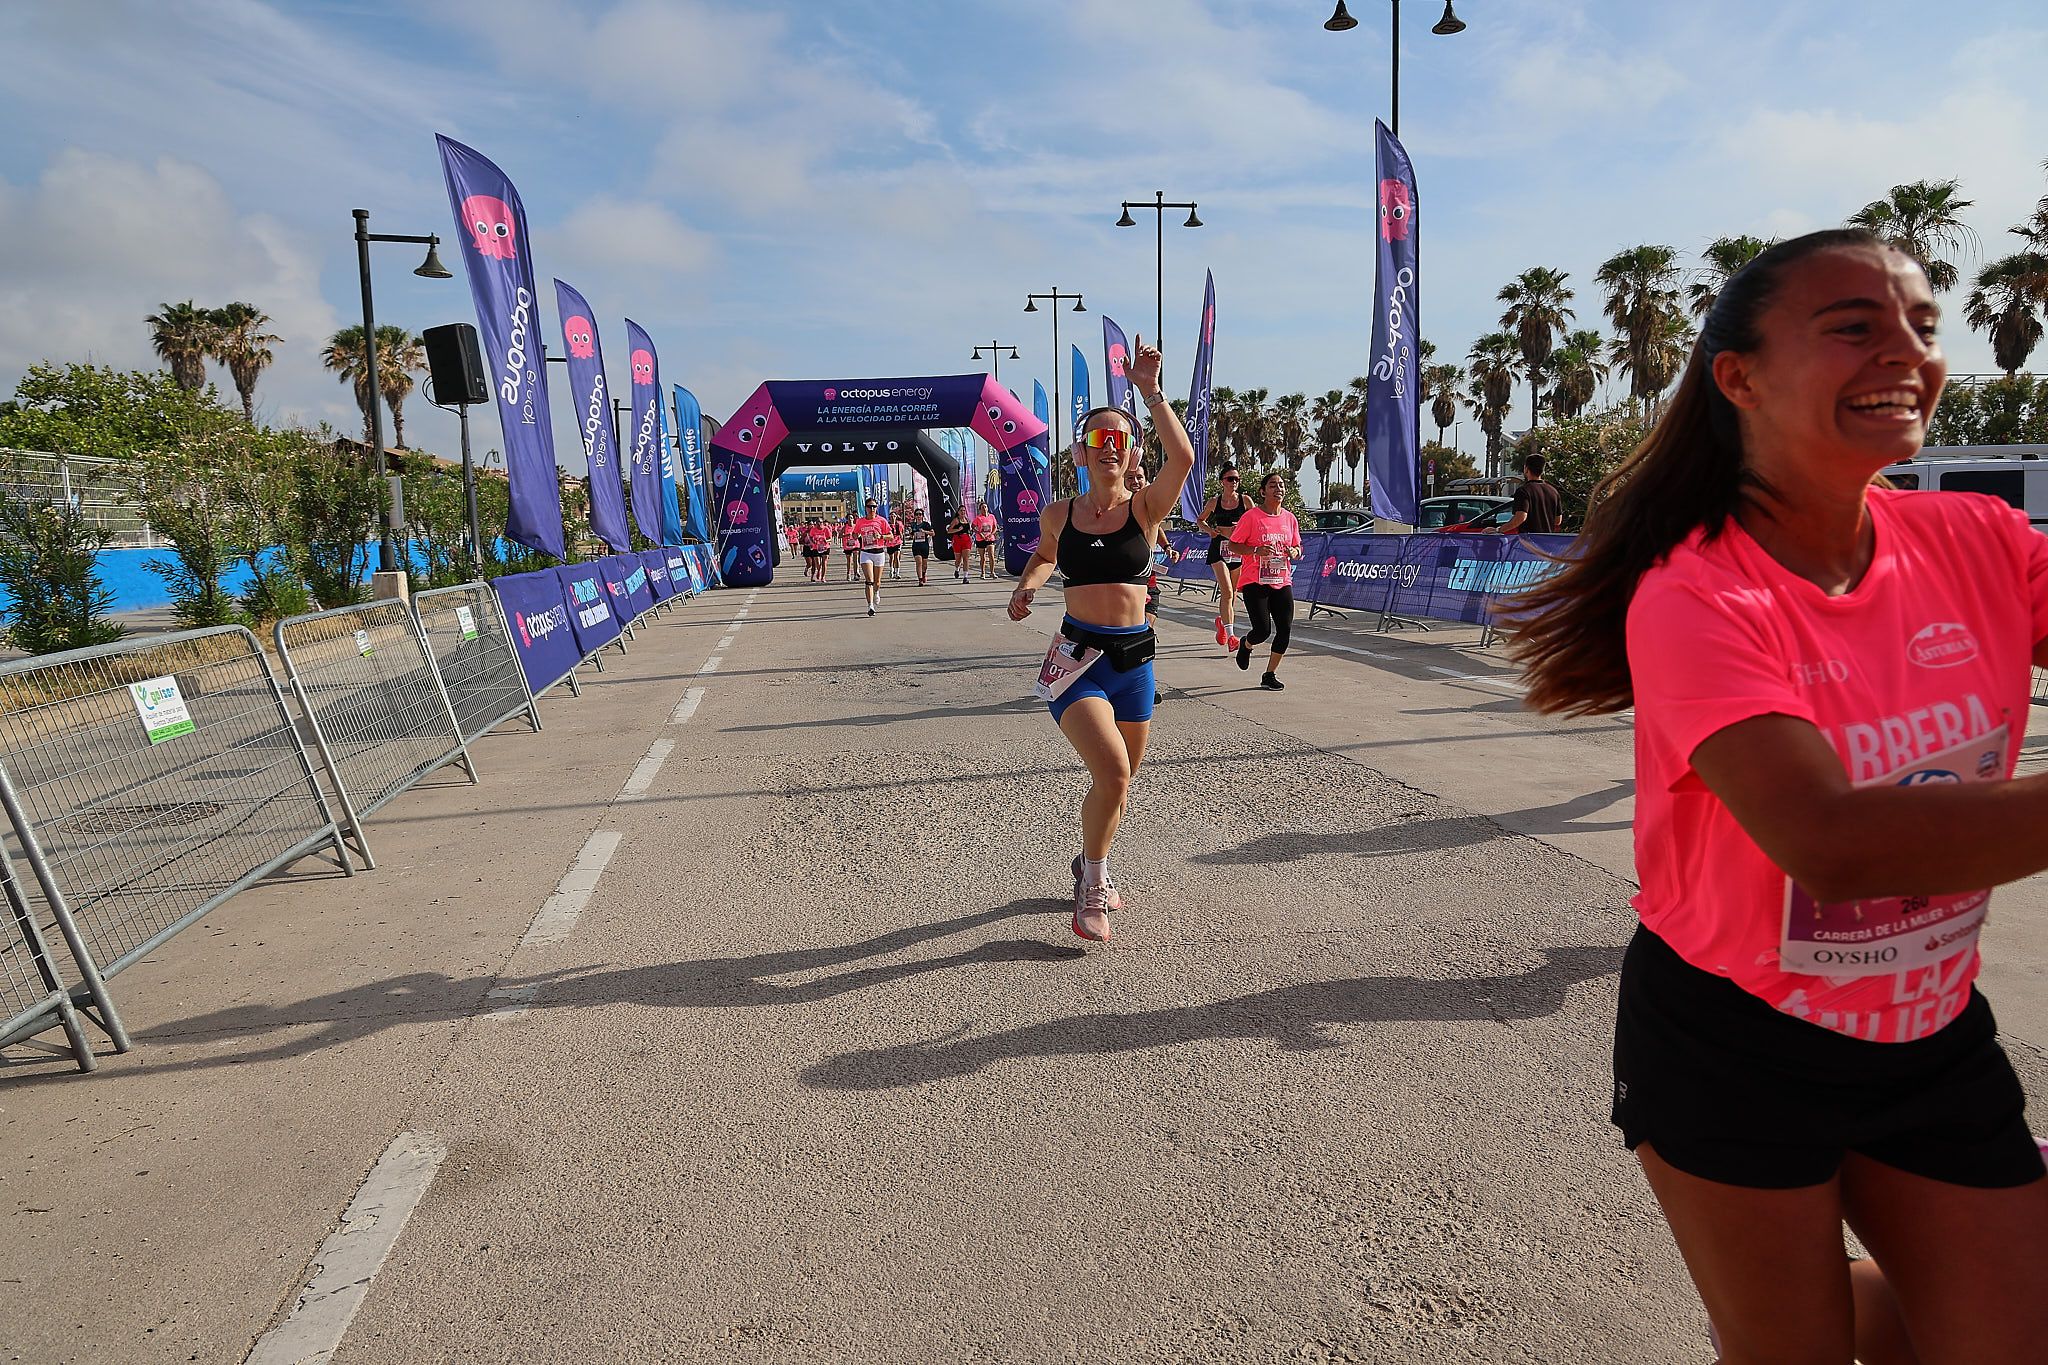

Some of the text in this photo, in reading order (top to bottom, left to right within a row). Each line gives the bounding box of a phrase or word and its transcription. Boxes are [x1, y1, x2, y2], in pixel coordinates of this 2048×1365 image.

[841, 387, 933, 400] octopus energy
[817, 404, 938, 414] LA ENERGÍA PARA CORRER
[840, 415, 892, 423] VELOCIDAD
[797, 441, 899, 453] VOLVO
[805, 474, 840, 490] Marlene
[1338, 559, 1421, 588] octopus energy
[1813, 929, 1873, 942] CARRERA
[1875, 924, 1891, 936] DE
[1893, 920, 1909, 932] LA
[1910, 908, 1945, 929] MUJER
[1813, 946, 1898, 964] OYSHO
